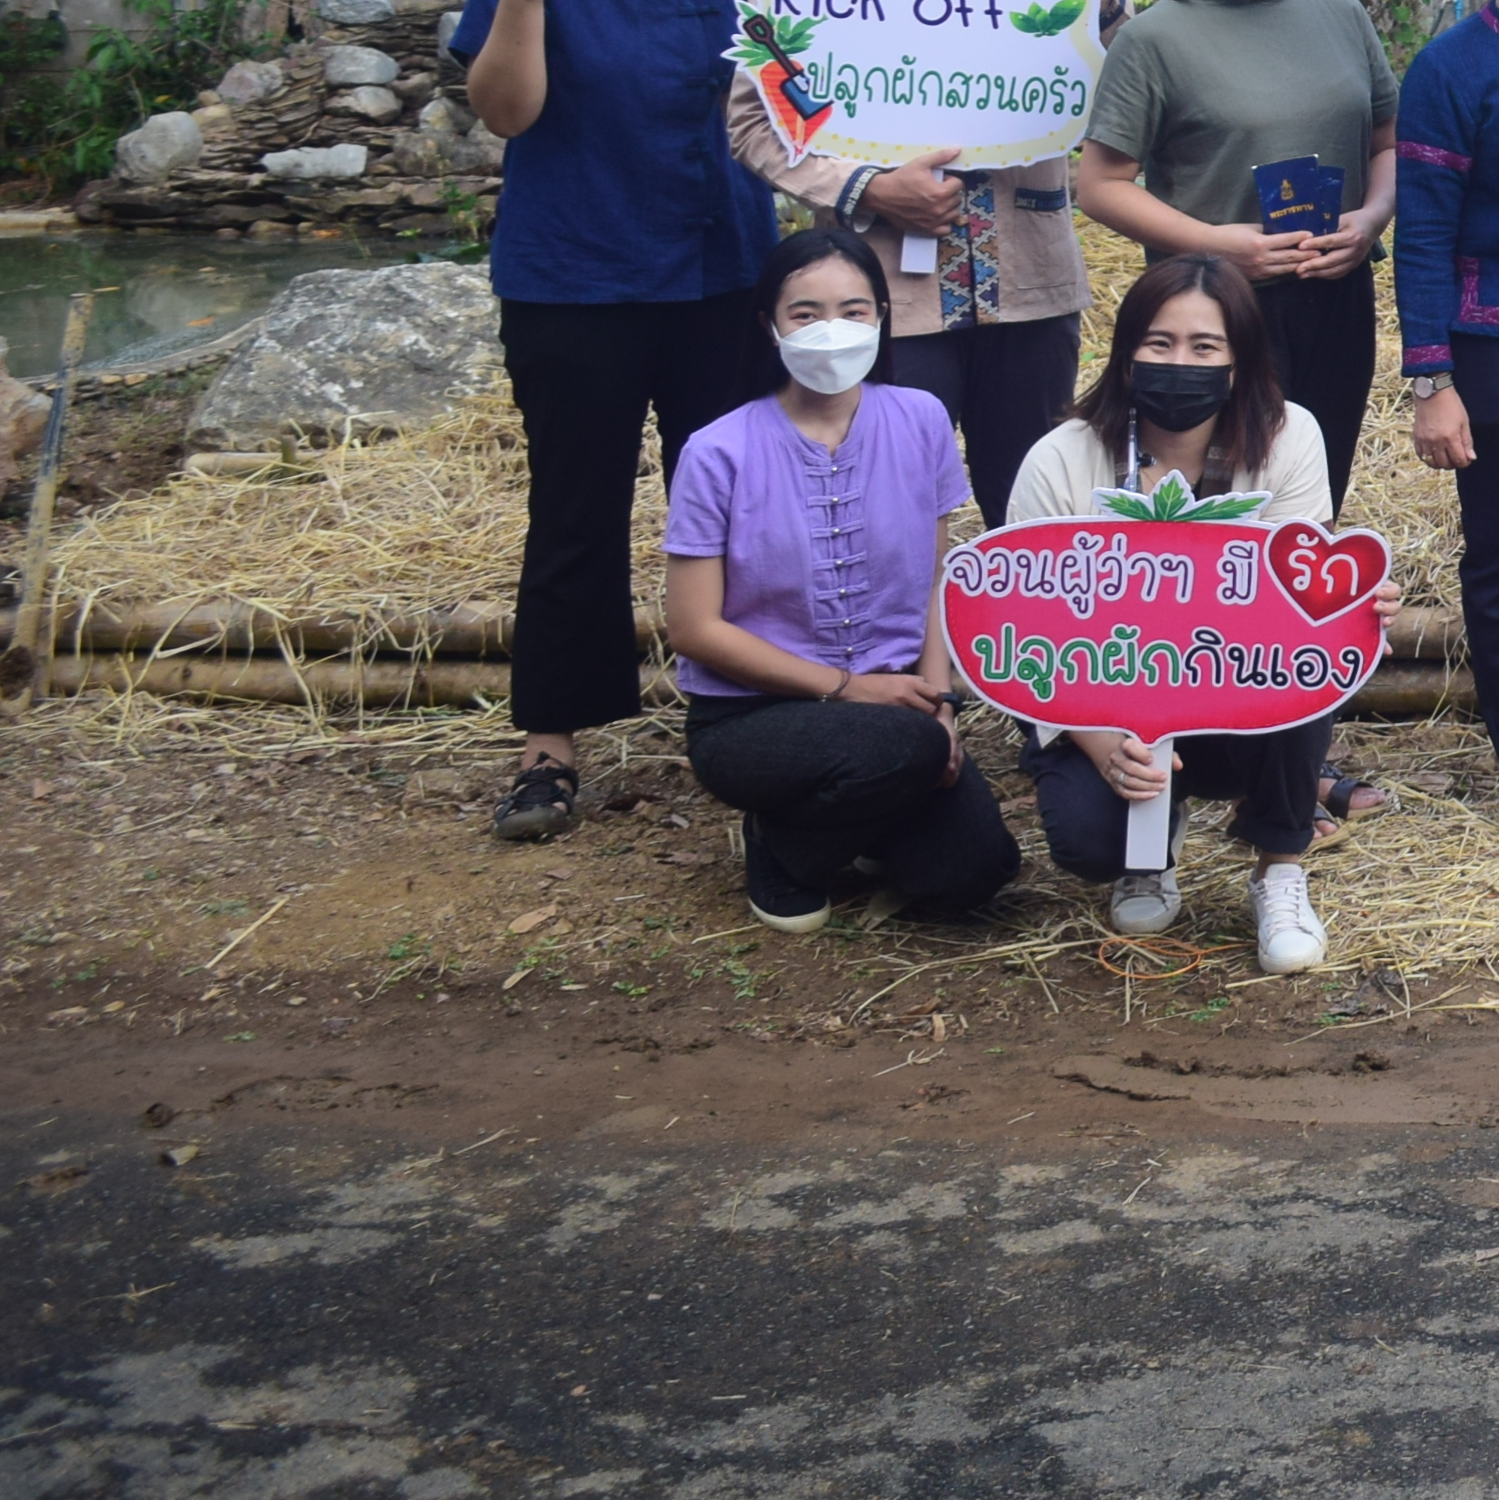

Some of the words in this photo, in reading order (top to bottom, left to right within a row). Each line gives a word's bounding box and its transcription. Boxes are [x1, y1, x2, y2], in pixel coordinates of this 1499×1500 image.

[807, 51, 1088, 119] ปลูกผักสวนครัว
[1219, 542, 1258, 601] มี
[1287, 534, 1359, 597] รัก
[973, 623, 1363, 701] ปลูกผักกินเอง
